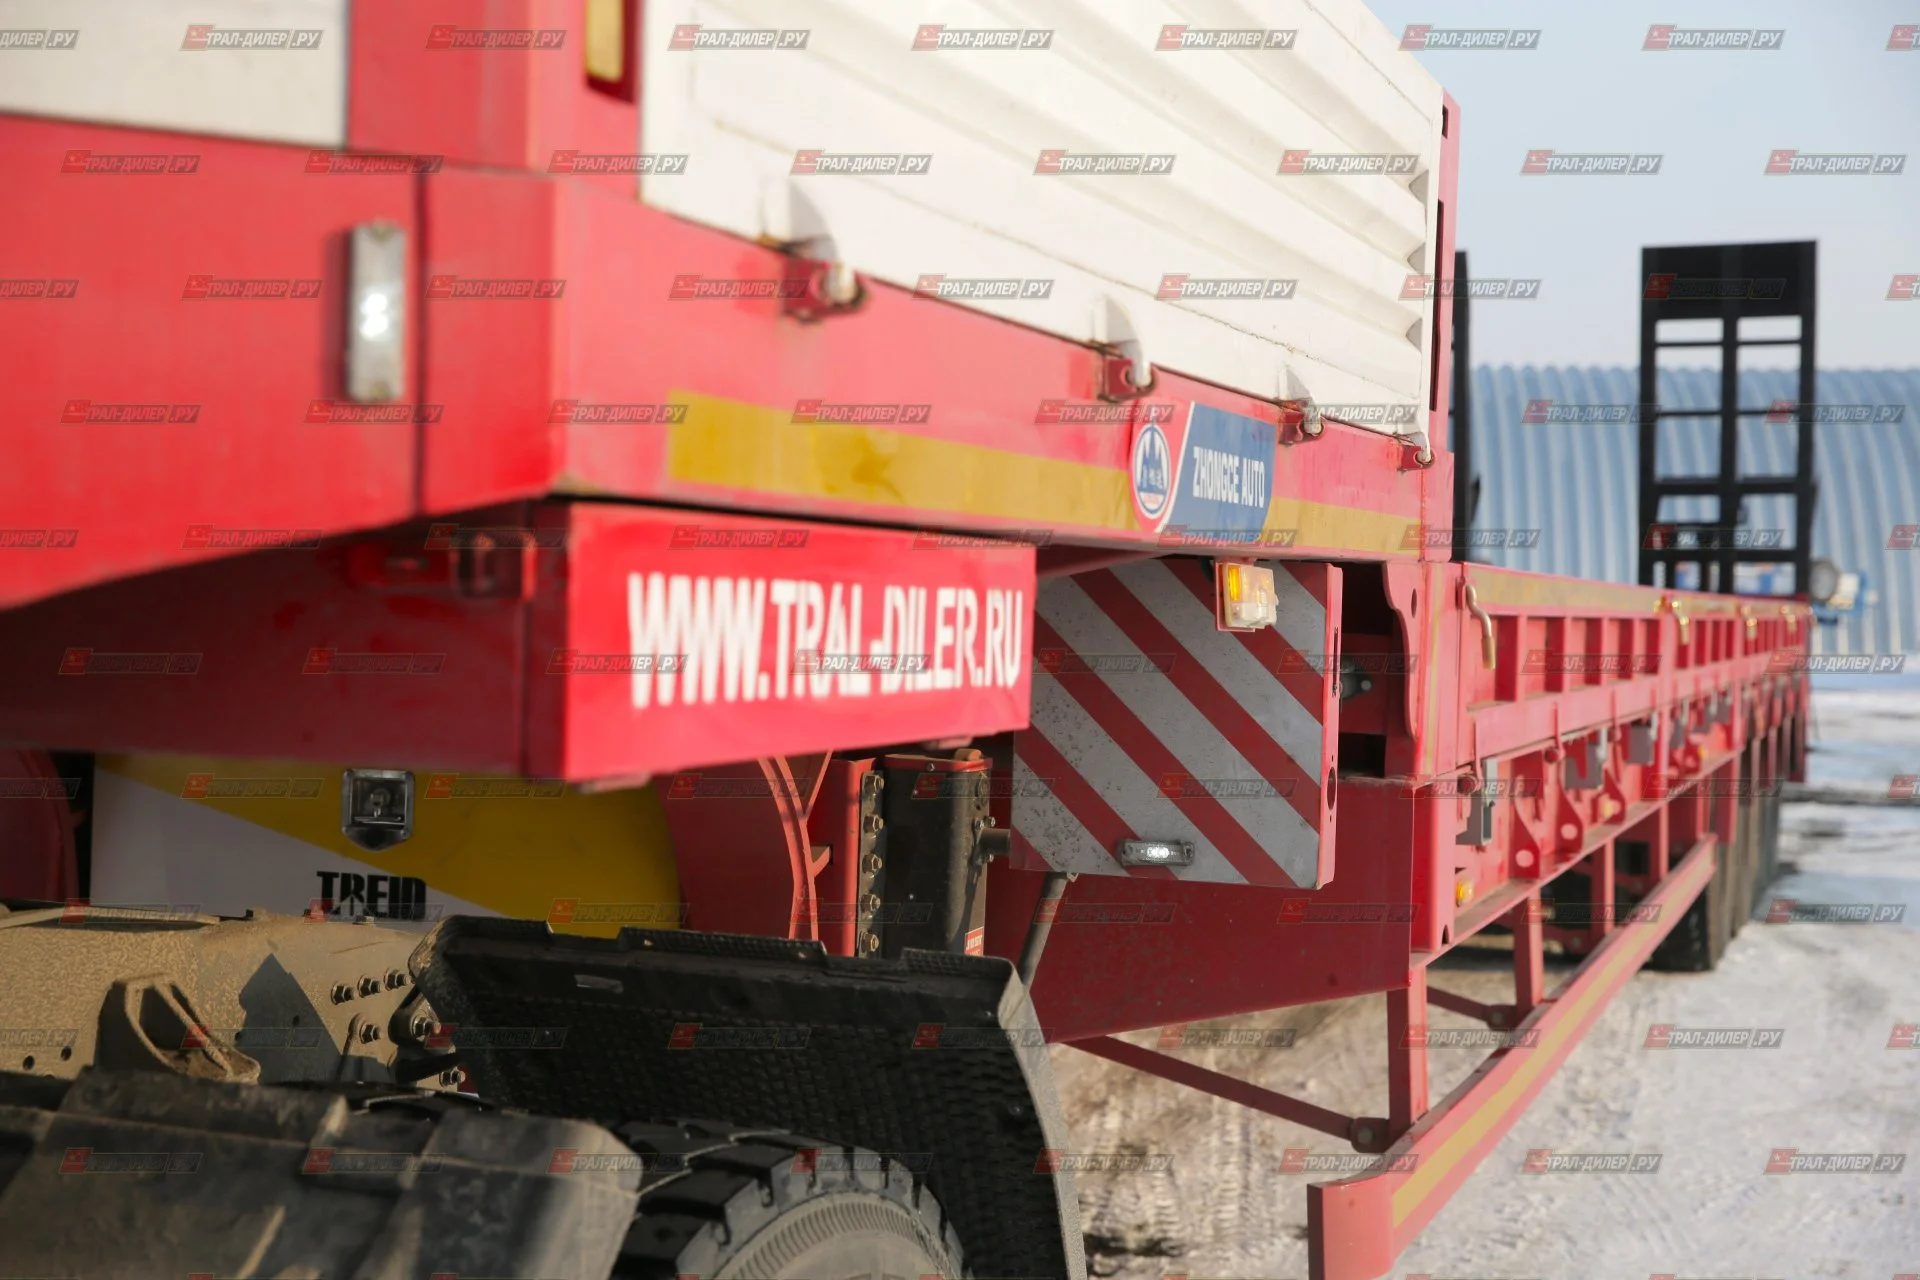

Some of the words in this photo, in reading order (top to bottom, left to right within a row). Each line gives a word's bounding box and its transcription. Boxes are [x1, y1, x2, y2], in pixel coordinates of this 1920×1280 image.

[1193, 446, 1239, 504] ZHONGCE
[1241, 458, 1265, 508] AUTO
[627, 571, 1023, 709] WWW.TRAL-DILER.RU
